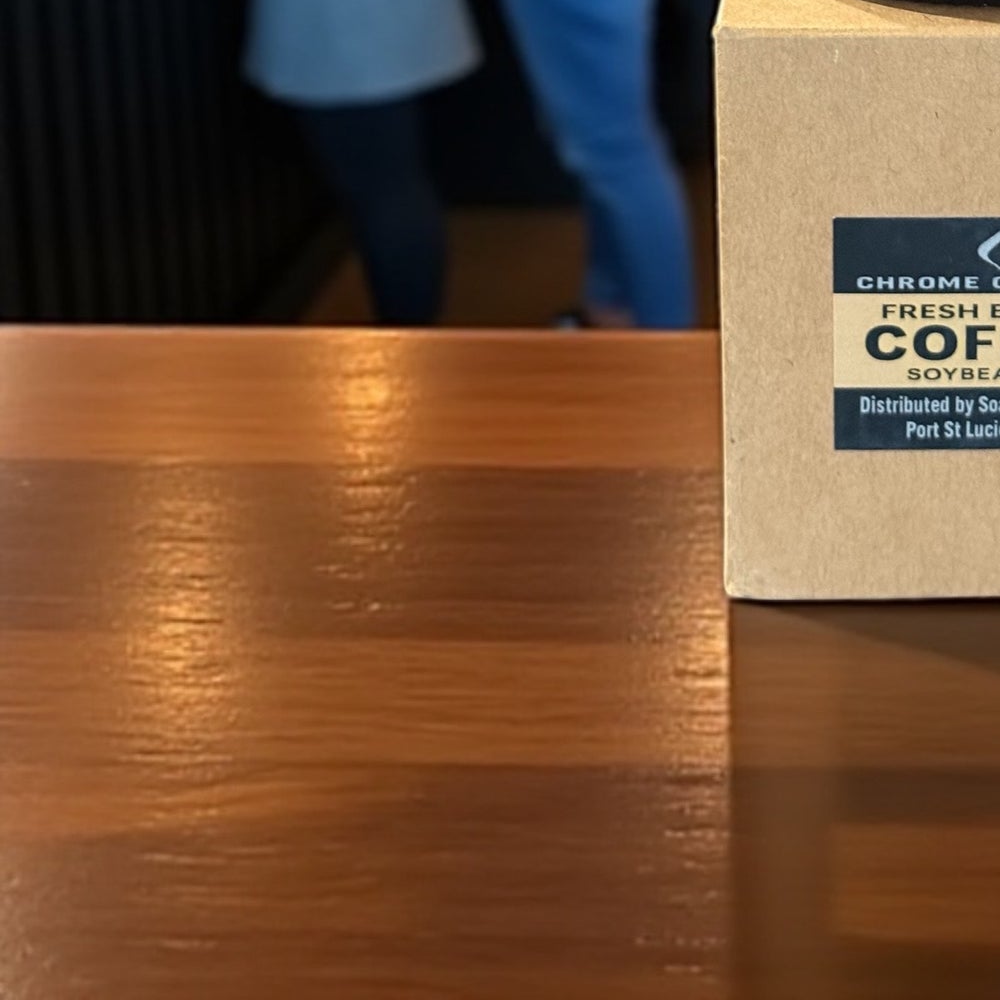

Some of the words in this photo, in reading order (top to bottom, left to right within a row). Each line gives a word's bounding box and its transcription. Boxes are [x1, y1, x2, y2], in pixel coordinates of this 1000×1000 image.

[856, 275, 980, 290] CHROME
[881, 303, 979, 319] FRESH
[859, 395, 950, 414] Distributed
[955, 395, 973, 416] by
[906, 421, 940, 439] Port
[944, 421, 962, 439] St
